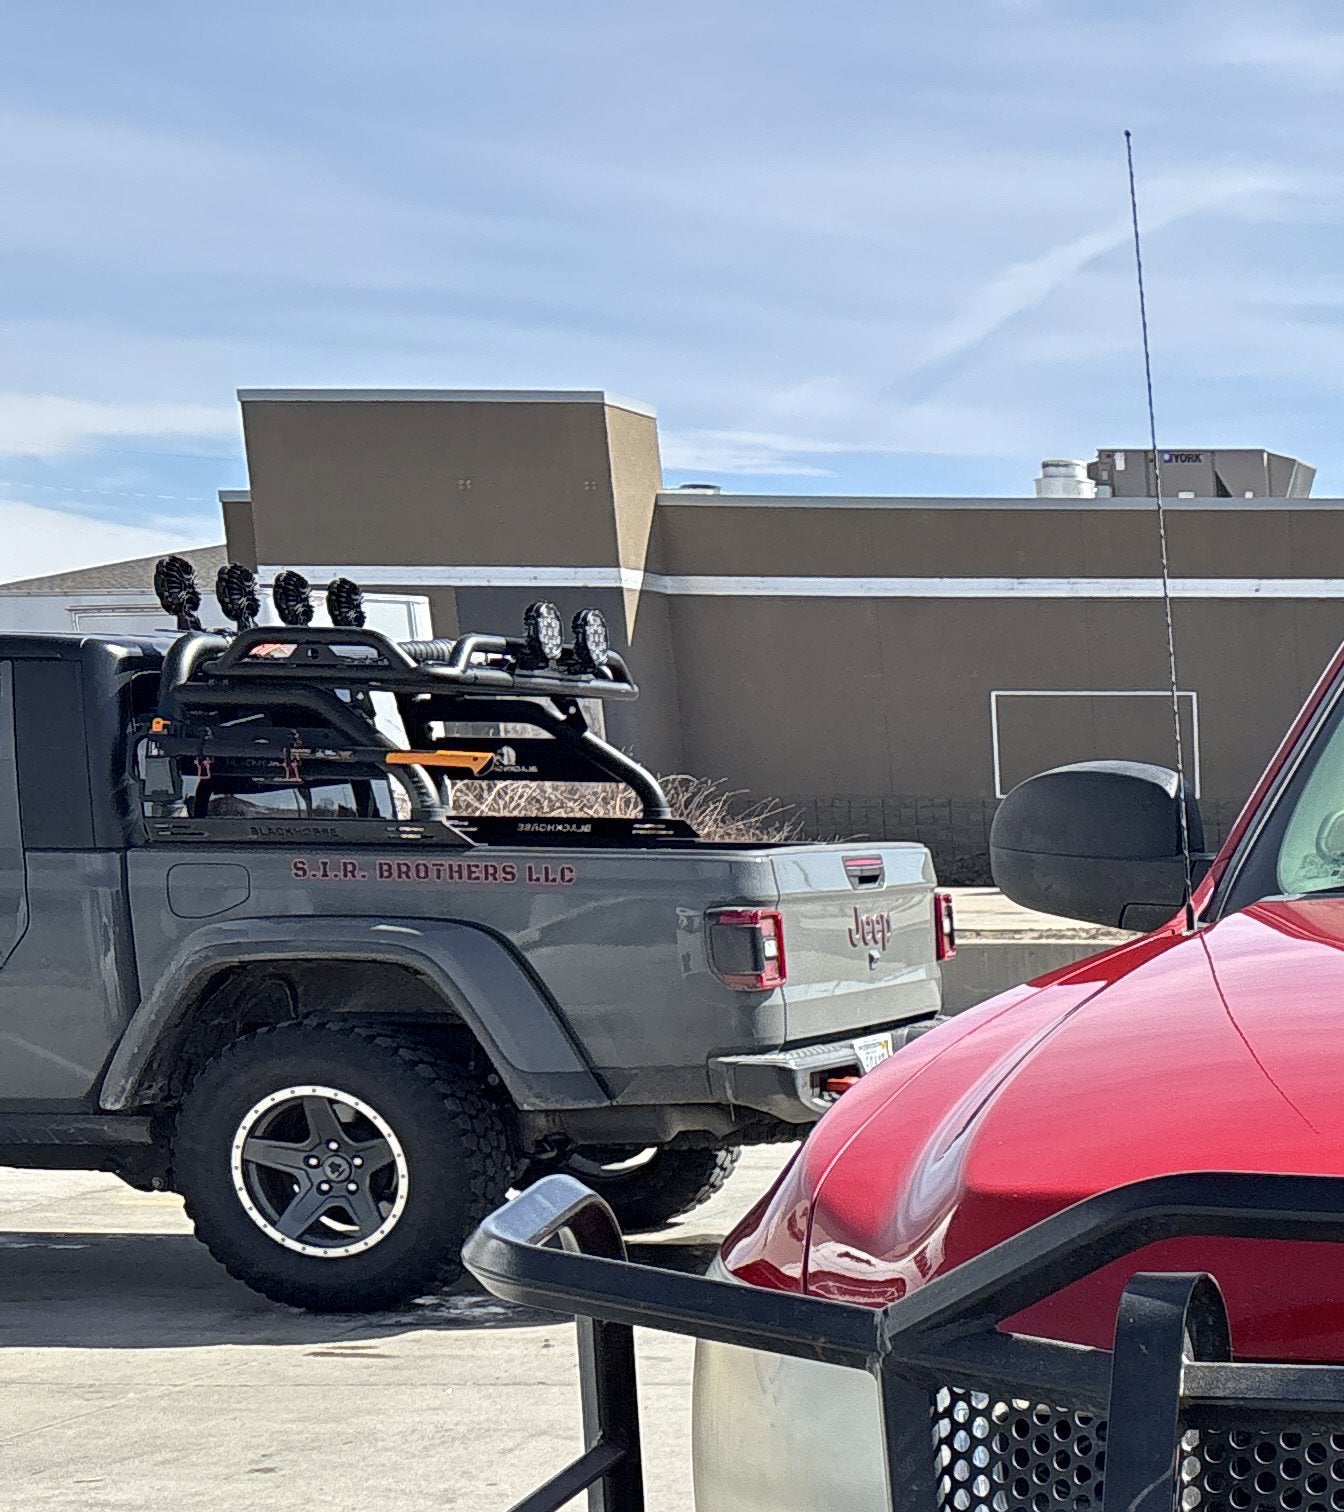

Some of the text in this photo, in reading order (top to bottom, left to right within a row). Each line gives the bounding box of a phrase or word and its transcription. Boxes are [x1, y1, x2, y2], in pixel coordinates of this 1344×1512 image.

[292, 860, 575, 883] S.I.R. BROTHERS LLC
[848, 905, 891, 951] Jeep
